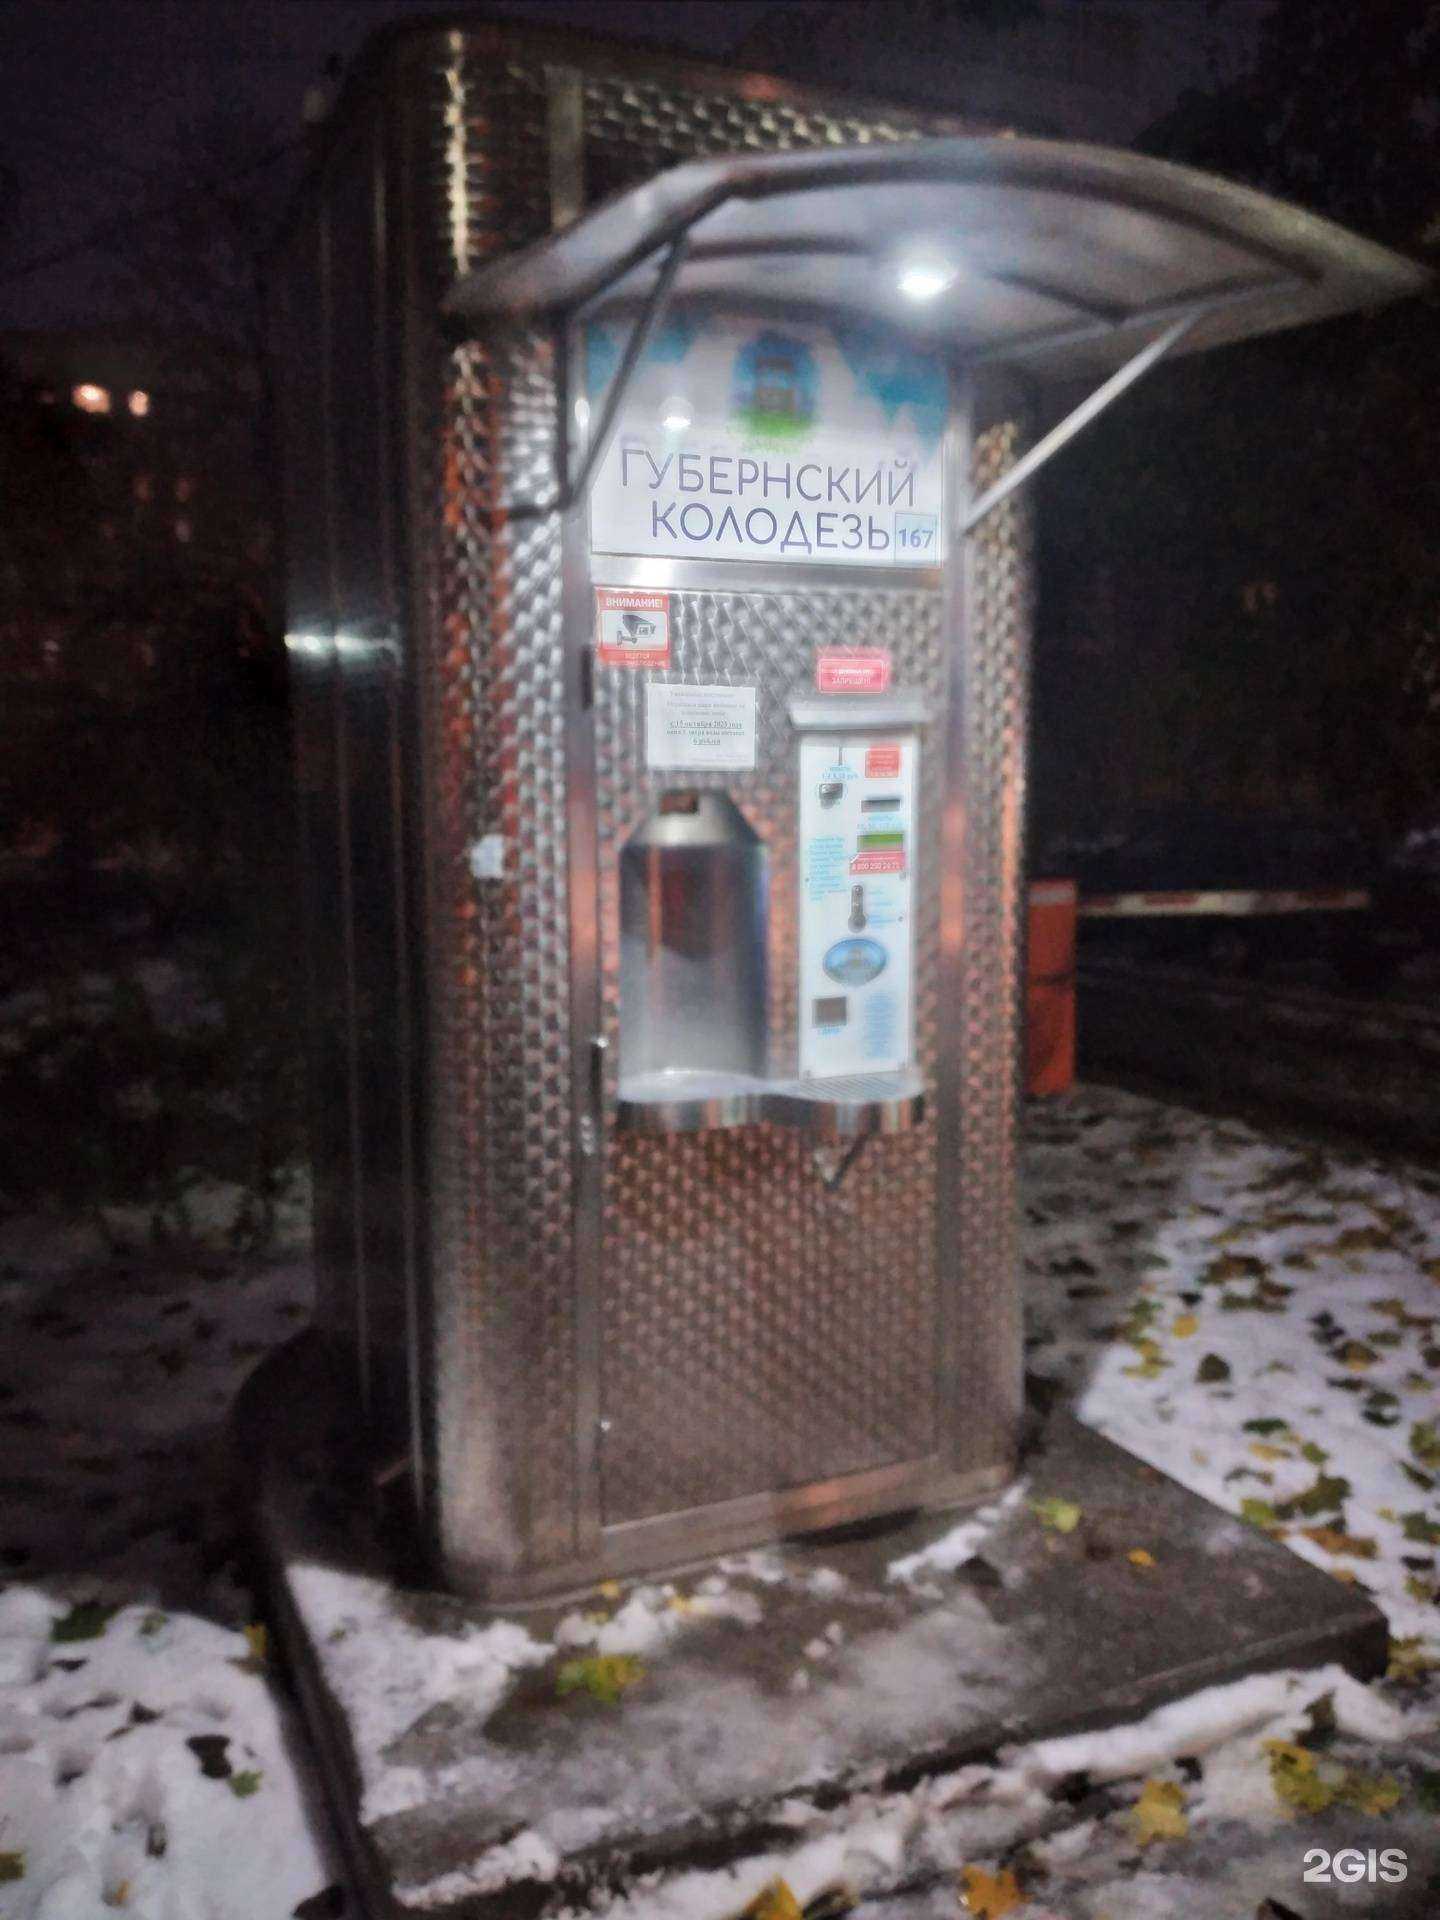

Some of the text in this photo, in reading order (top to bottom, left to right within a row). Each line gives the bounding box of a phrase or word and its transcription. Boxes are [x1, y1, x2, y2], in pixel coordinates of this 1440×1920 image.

[622, 449, 914, 507] ГУБЕРНСКИЙ
[652, 500, 890, 554] КОЛОДЕЗЬ
[898, 528, 935, 549] 167
